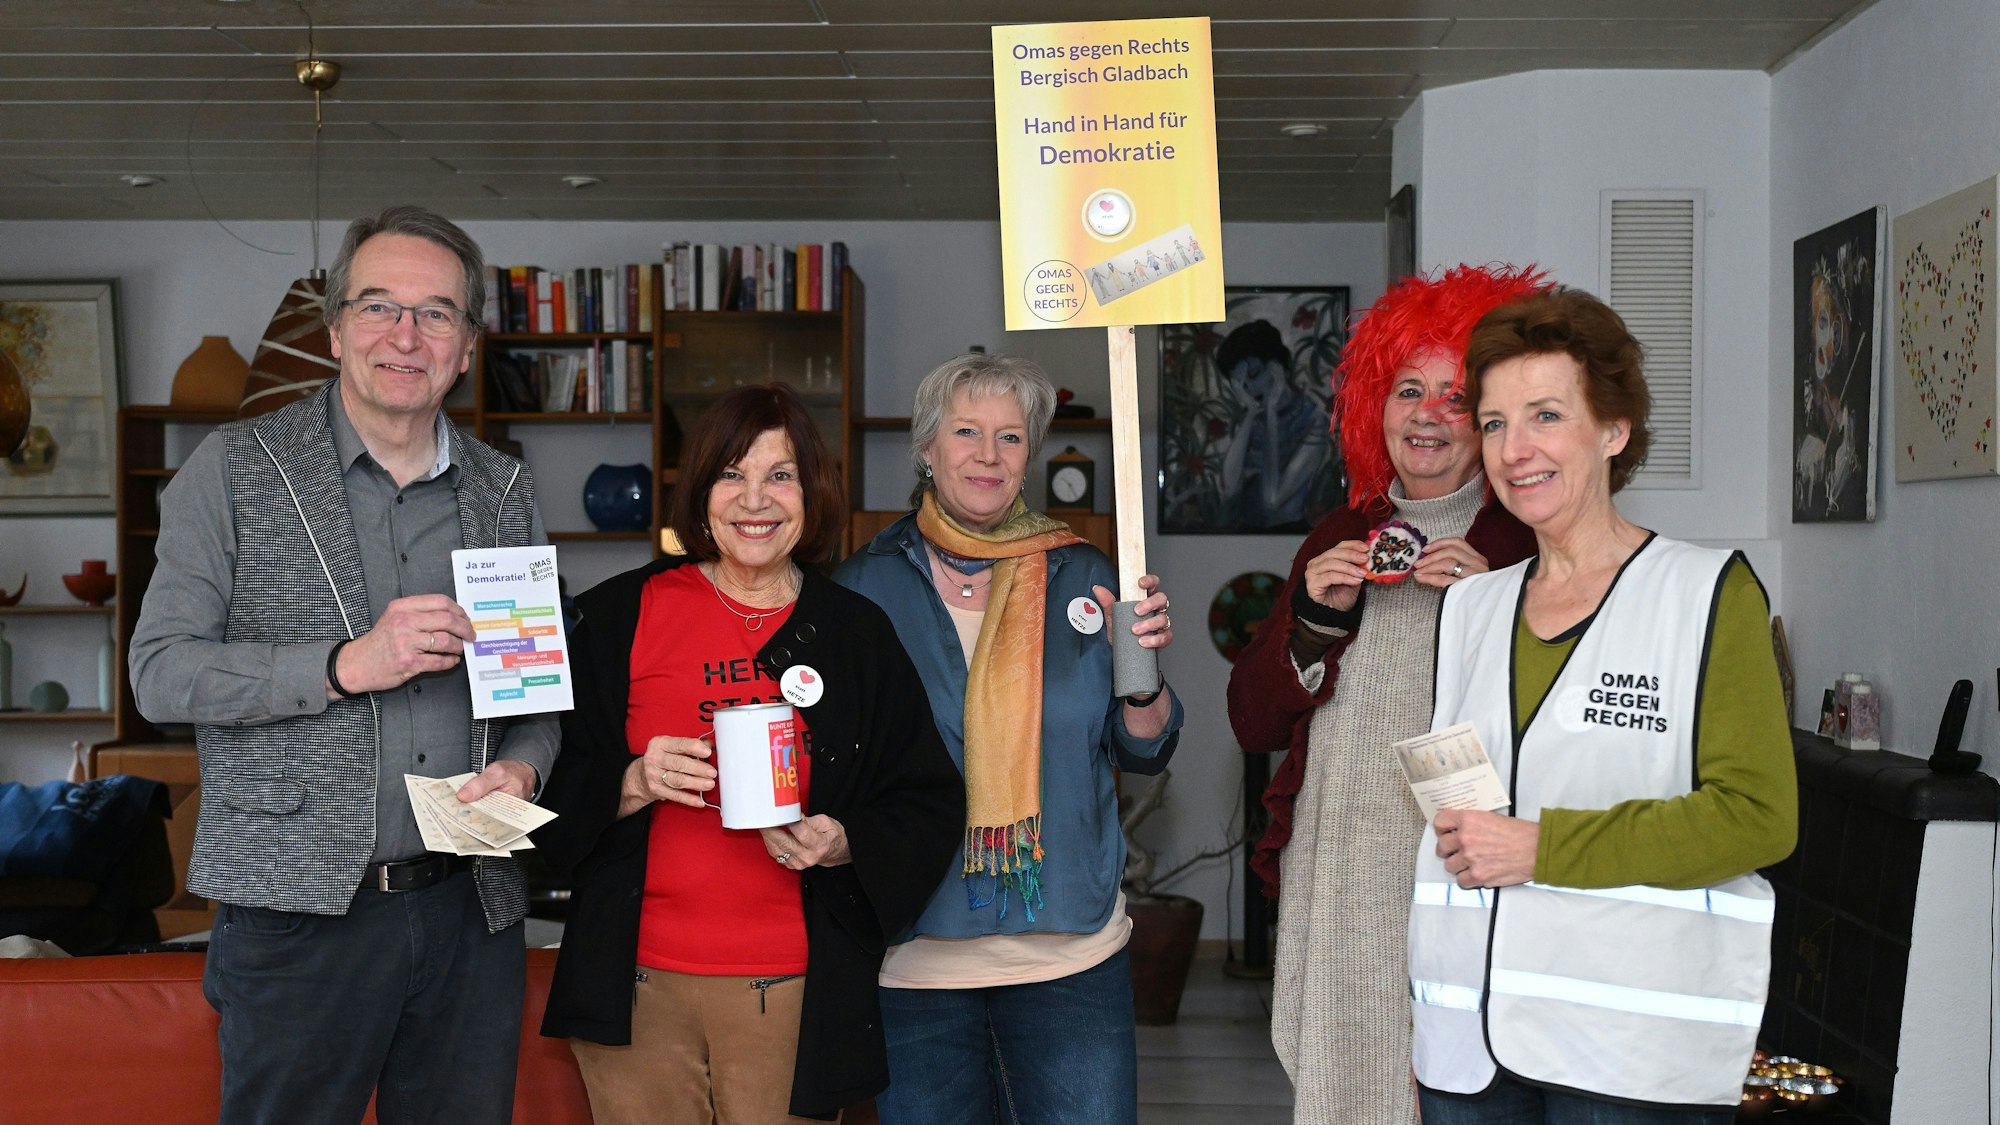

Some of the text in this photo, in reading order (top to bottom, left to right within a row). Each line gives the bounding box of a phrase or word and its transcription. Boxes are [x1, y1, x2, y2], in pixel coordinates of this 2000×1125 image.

[1012, 38, 1190, 61] Omas gegen Rechts
[1020, 64, 1189, 88] Bergisch Gladbach
[1024, 111, 1188, 134] Hand in Hand für
[1040, 141, 1175, 165] Demokratie
[1037, 268, 1072, 279] OMAS
[1036, 283, 1075, 294] GEGEN
[1034, 298, 1078, 310] RECHTS
[465, 561, 496, 570] Ja zur
[529, 558, 552, 570] OMAS
[537, 566, 553, 575] GEGEN
[467, 573, 526, 584] Demokratie!
[532, 572, 555, 582] RECHTS
[704, 658, 777, 686] HER
[1601, 672, 1659, 692] OMAS
[787, 689, 806, 703] HETZE
[1588, 688, 1660, 712] GEGEN
[1583, 707, 1668, 733] RECHTS
[769, 723, 787, 731] BUNTE
